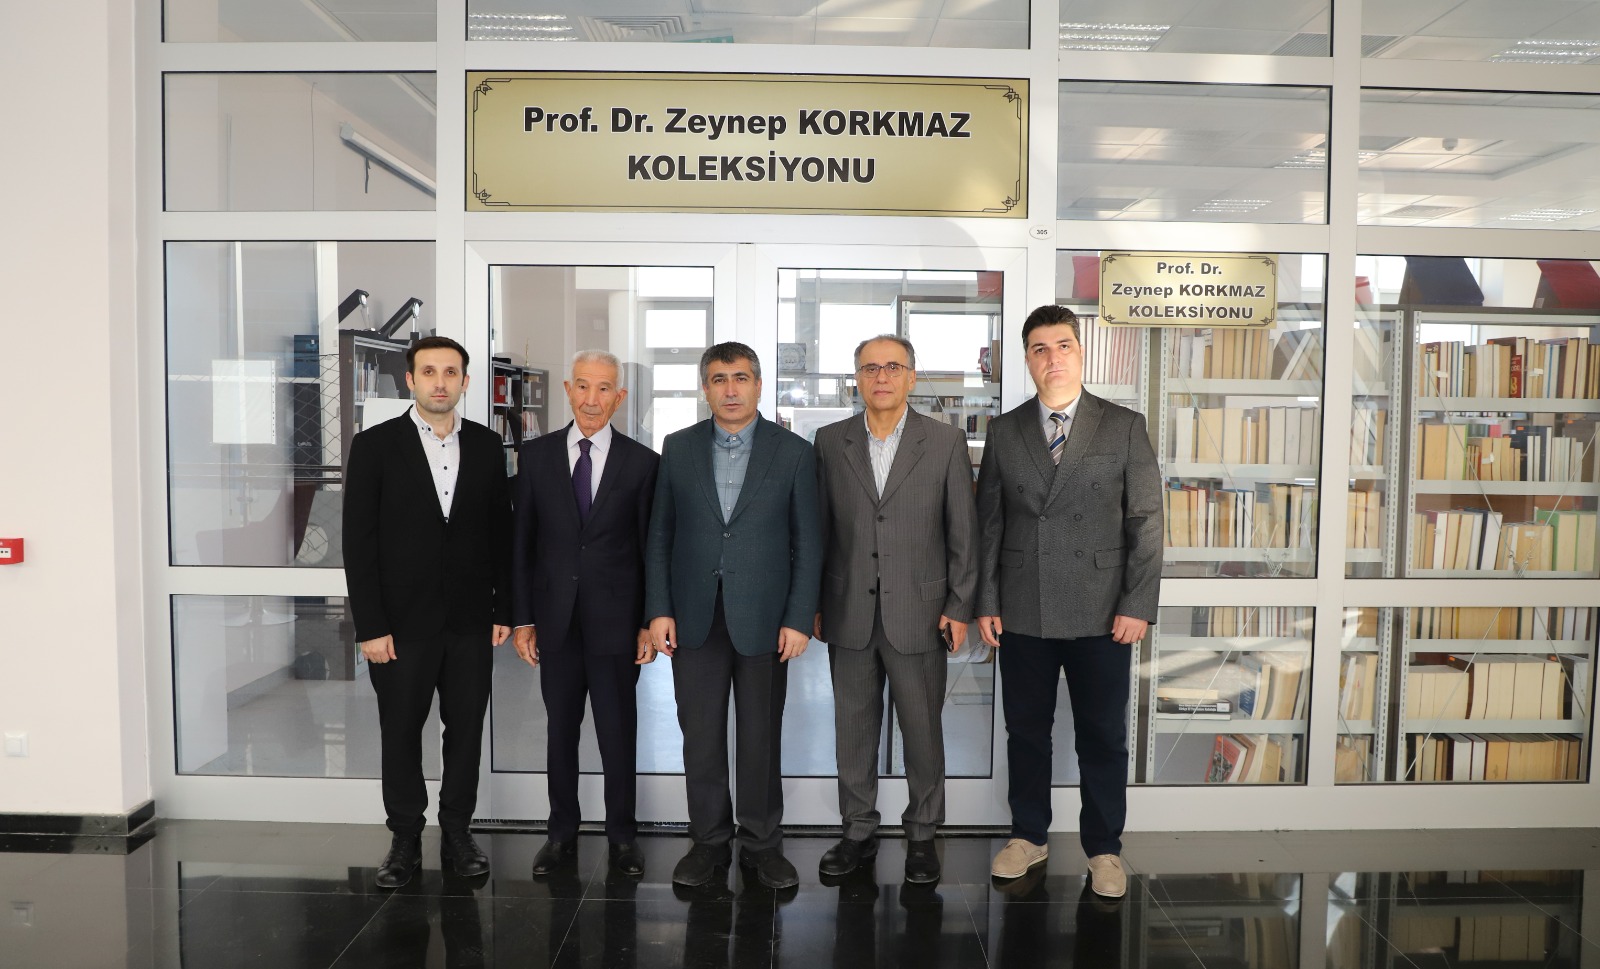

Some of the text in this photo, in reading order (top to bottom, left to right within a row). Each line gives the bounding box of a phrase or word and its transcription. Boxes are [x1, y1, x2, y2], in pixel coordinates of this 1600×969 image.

[524, 107, 971, 141] Prof. Dr. Zeynep KORKMAZ
[628, 150, 875, 184] KOLEKSİYONU
[1157, 262, 1222, 275] Prof. Dr.
[1111, 283, 1266, 299] Zeynep KORKMAZ
[1128, 303, 1253, 319] KOLEKSİYONU
